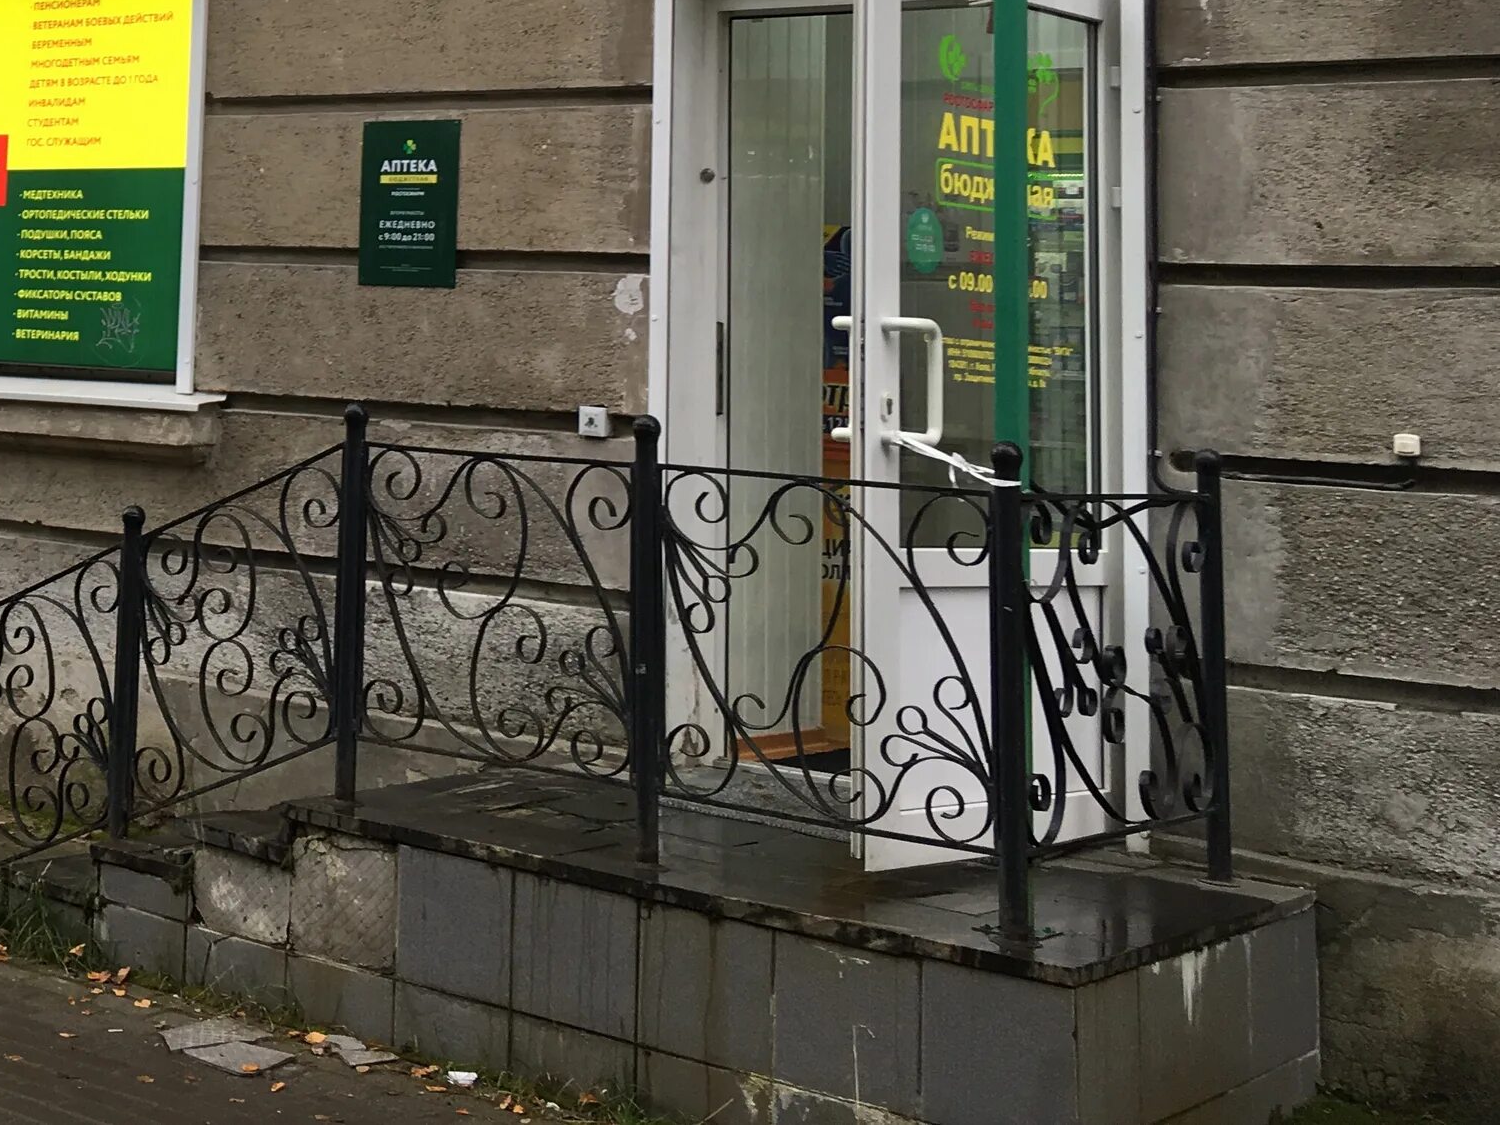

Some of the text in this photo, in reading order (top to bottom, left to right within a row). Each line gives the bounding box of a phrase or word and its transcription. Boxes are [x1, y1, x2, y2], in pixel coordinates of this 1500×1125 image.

[32, 11, 174, 31] ВЕТЕРАНАМ БОЕВЫХ ДЕЙСТВИЙ
[32, 38, 92, 50] БЕРЕМЕННЫМ
[30, 55, 140, 69] МНОГОДЕТНЫМ СЕМЬЯМ
[29, 78, 58, 89] ДЕТЯМ
[60, 78, 66, 87] В
[67, 76, 111, 87] ВОЗРАСТЕ
[113, 75, 127, 86] ДО
[134, 74, 159, 84] ГОДА
[28, 97, 86, 107] ИНВАЛИДАМ
[27, 117, 80, 128] СТУДЕНТАМ
[46, 136, 102, 147] СЛУЖАЩИМ
[938, 112, 1056, 168] АПТКА
[380, 159, 438, 173] АПТЕКА
[106, 209, 150, 220] СТЕЛЬКИ
[379, 220, 436, 229] ЕЖЕДНЕВНО
[70, 229, 103, 240] ПОЯСА
[63, 250, 111, 261] БАНДАЖИ
[105, 271, 152, 283] ХОДУНКИ
[960, 272, 994, 293] 09.00
[74, 290, 122, 302] СУСТАВОВ
